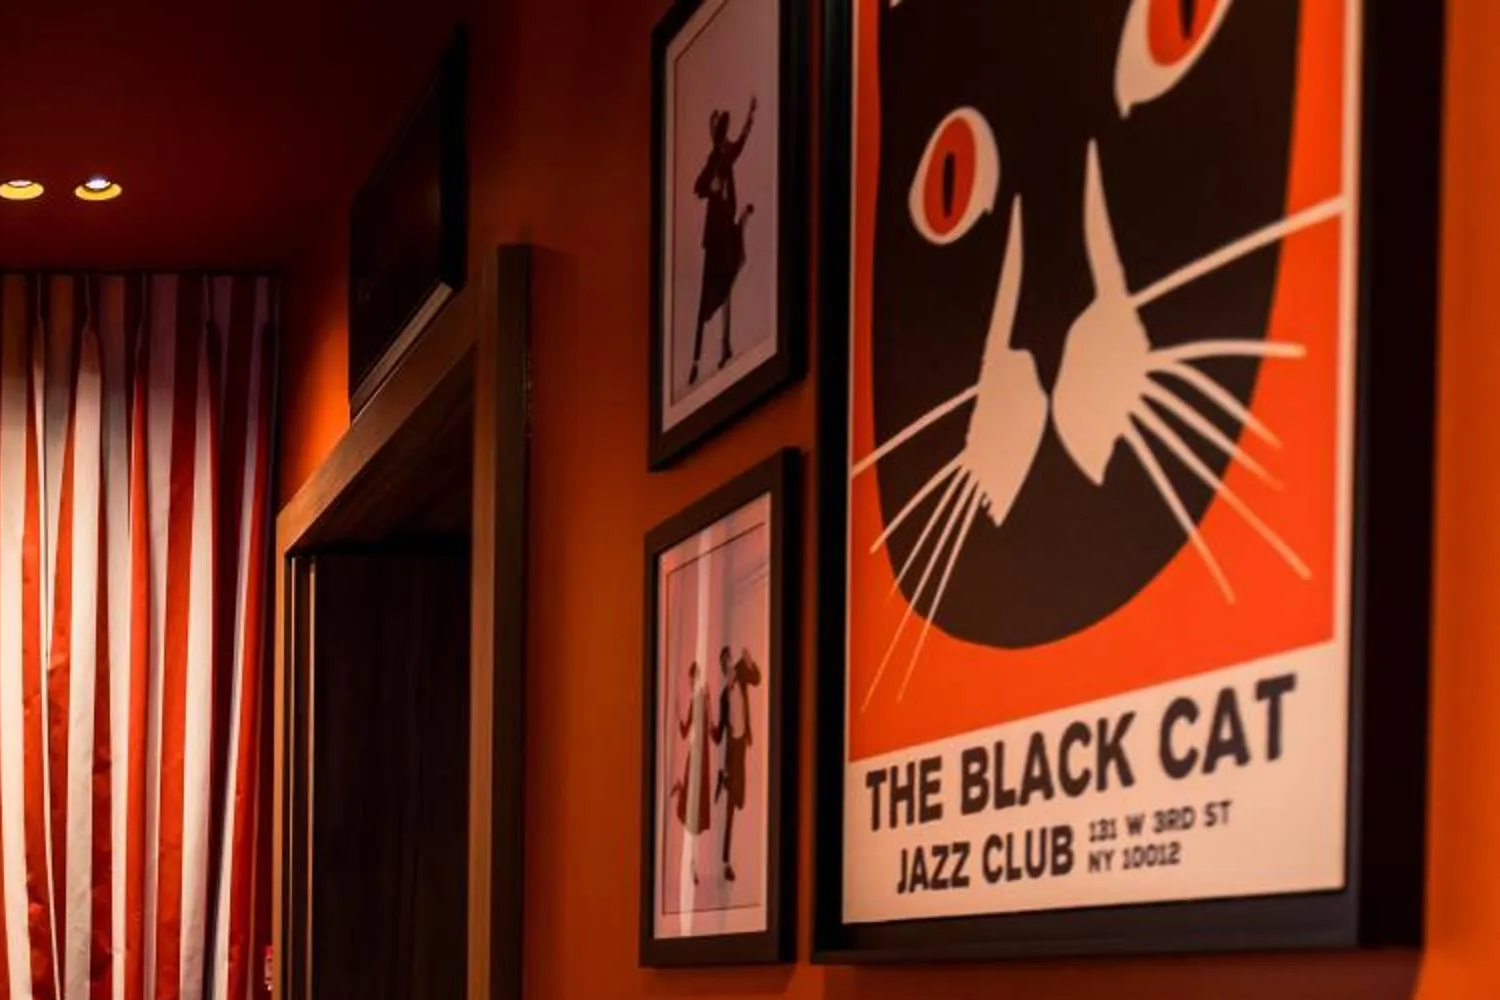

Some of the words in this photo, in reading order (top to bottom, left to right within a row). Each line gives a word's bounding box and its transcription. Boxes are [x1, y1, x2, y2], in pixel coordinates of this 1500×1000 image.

[866, 755, 943, 831] THE
[961, 711, 1136, 816] BLACK
[1159, 672, 1297, 780] CAT
[1088, 818, 1117, 843] 131
[1125, 813, 1146, 837] W
[1153, 805, 1196, 834] 3RD
[1204, 799, 1233, 828] ST
[897, 841, 971, 894] JAZZ
[982, 824, 1074, 884] CLUB
[1088, 849, 1115, 873] NY
[1123, 841, 1181, 871] 10012
